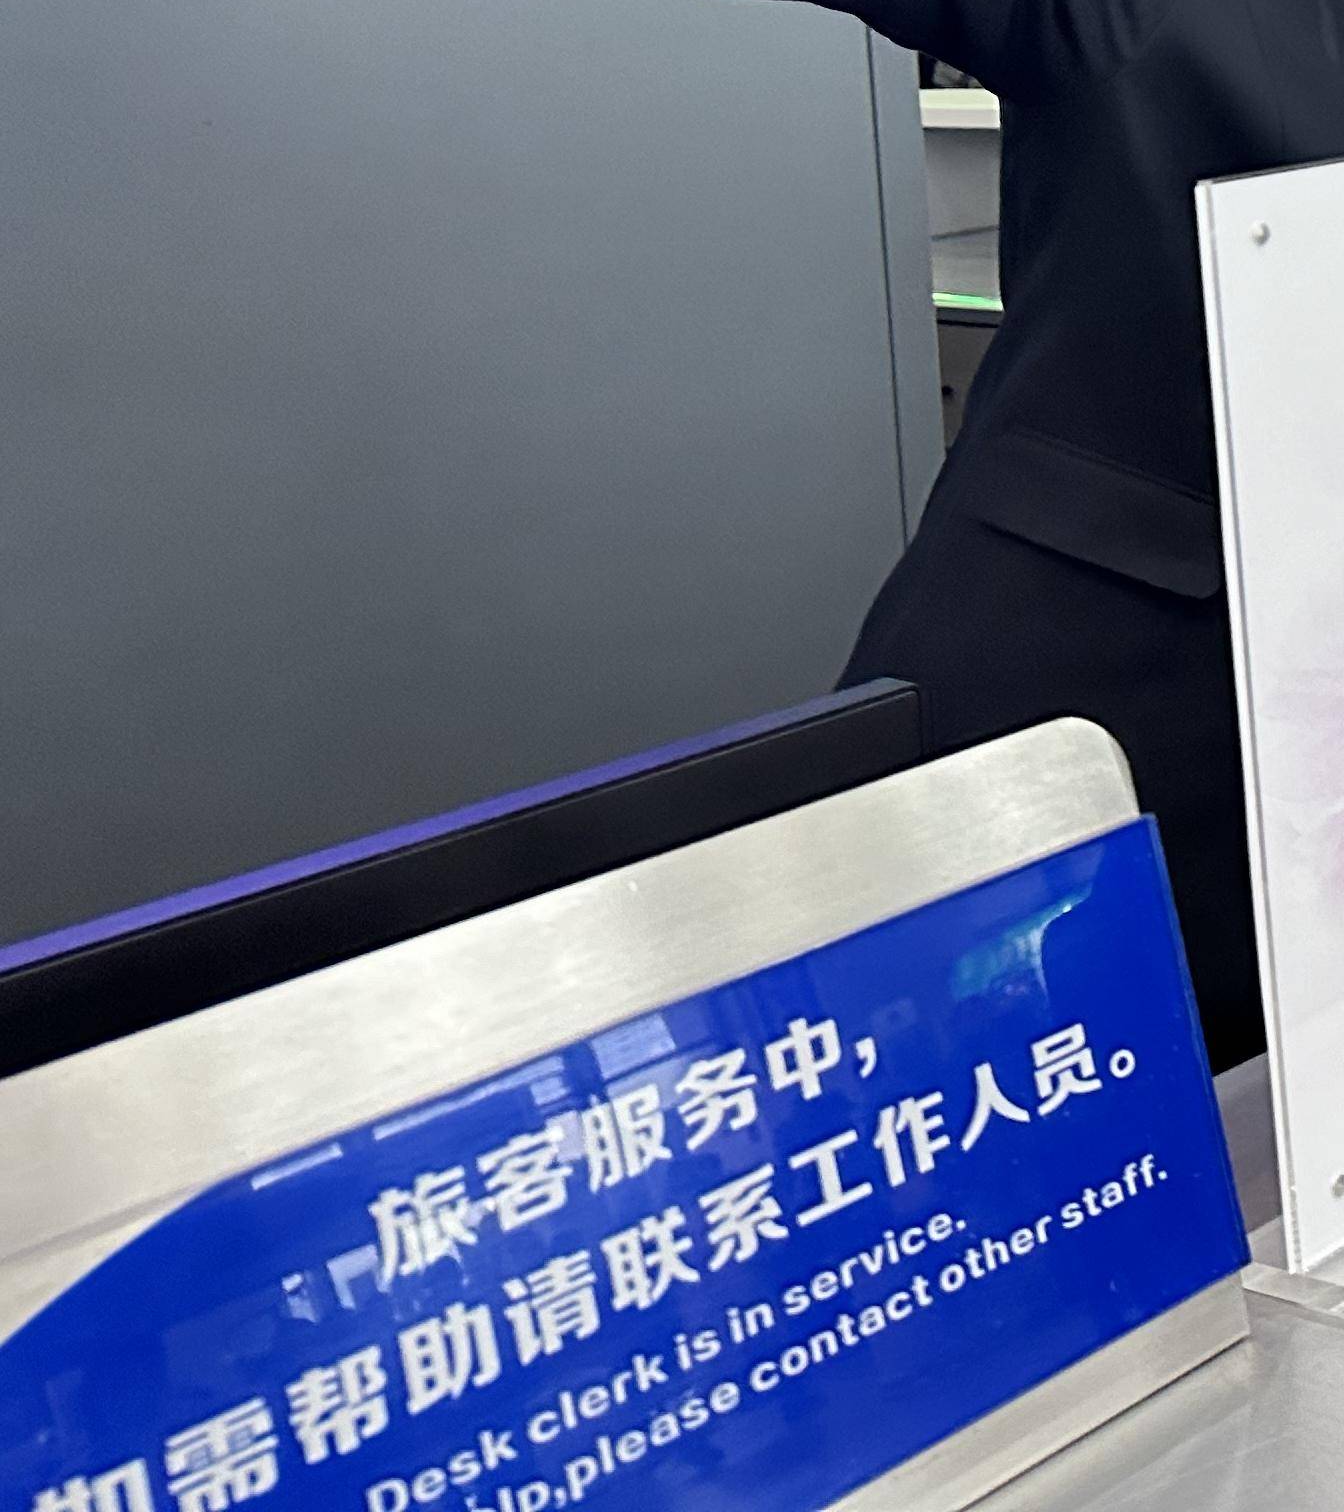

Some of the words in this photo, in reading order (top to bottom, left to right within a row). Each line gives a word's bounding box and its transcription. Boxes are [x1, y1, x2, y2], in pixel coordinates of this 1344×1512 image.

[365, 1429, 519, 1512] Desk
[526, 1354, 669, 1444] clerk
[675, 1332, 722, 1371] is
[727, 1305, 775, 1345] in
[783, 1216, 968, 1317] service.
[748, 1274, 934, 1393] contact
[939, 1214, 1052, 1294] other
[1061, 1152, 1169, 1231] staff.
